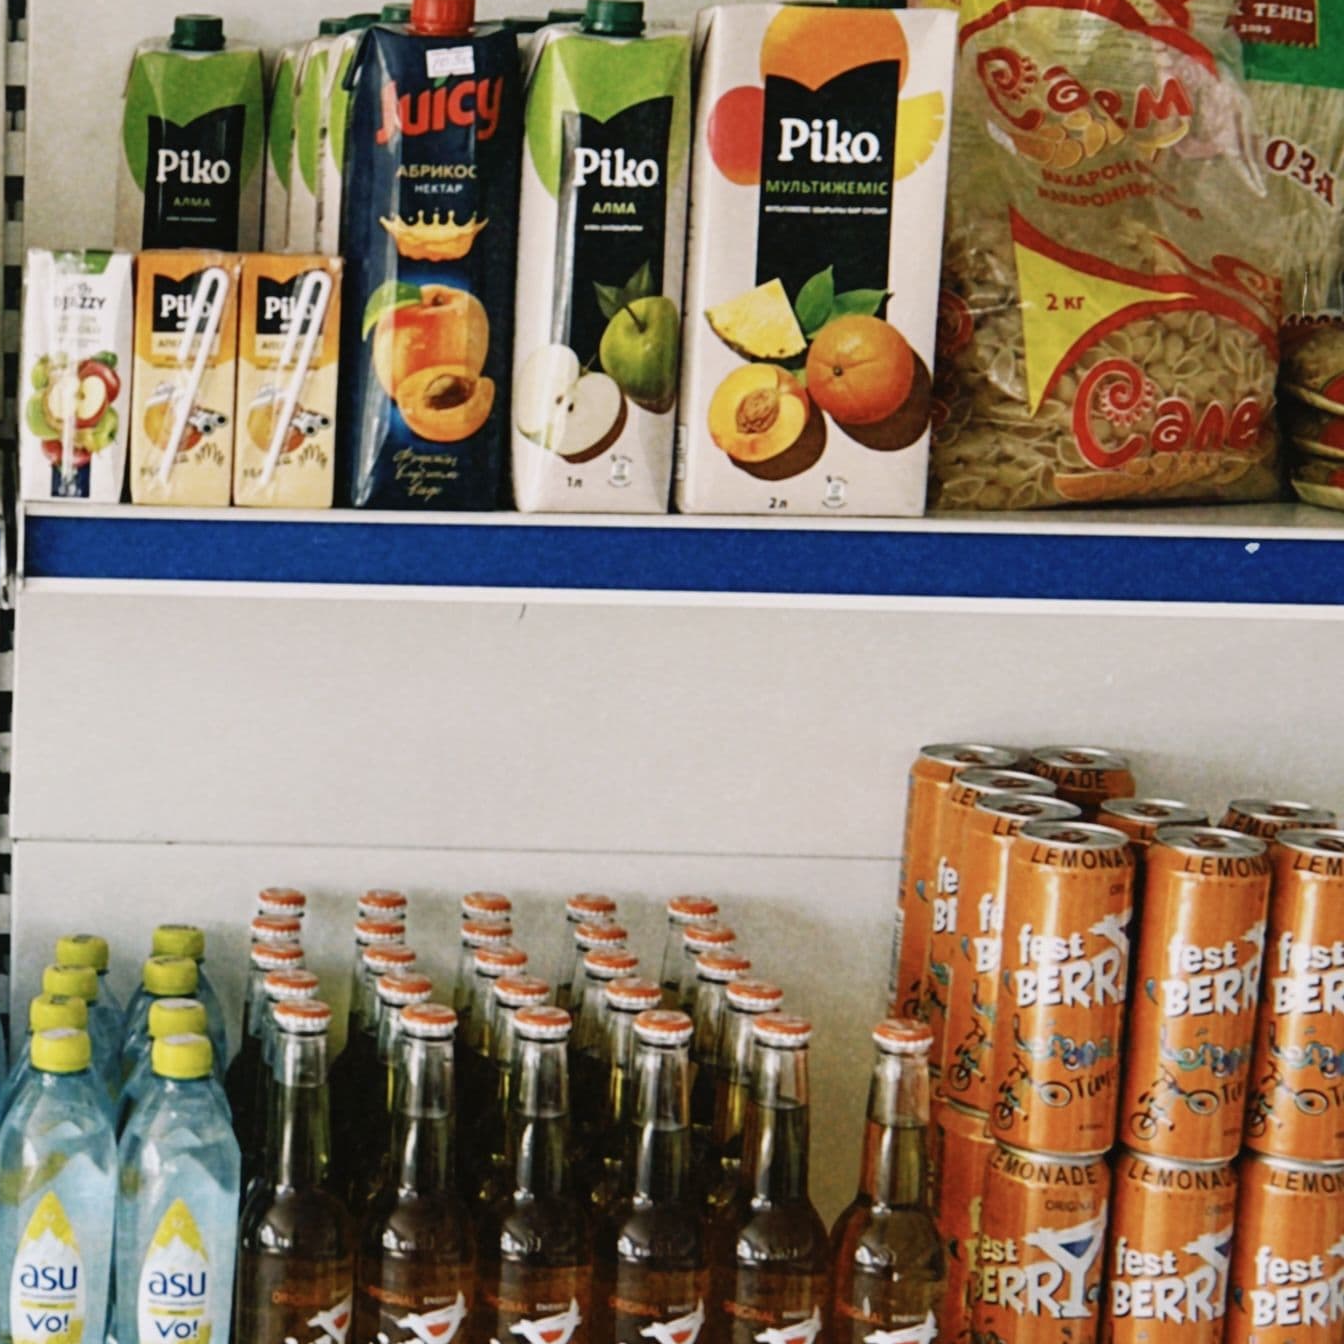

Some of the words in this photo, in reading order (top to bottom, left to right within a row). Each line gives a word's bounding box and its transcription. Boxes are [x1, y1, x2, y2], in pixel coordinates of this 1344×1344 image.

[777, 116, 882, 165] Piko
[155, 147, 233, 186] Piko
[396, 164, 478, 179] АБРИКОС
[572, 146, 660, 188] Piko
[413, 183, 464, 195] НЕКТАР
[765, 178, 889, 197] МУЛЬТИЖЕМІС
[173, 197, 212, 209] АЛМА
[592, 201, 637, 215] АЛМА
[1046, 293, 1057, 311] 2
[1063, 294, 1085, 311] кг
[1018, 922, 1086, 964] fest
[1168, 931, 1238, 975] fest
[1116, 1237, 1178, 1276] fest
[1255, 1245, 1325, 1286] fest
[19, 1262, 79, 1291] asu
[148, 1269, 208, 1298] asu
